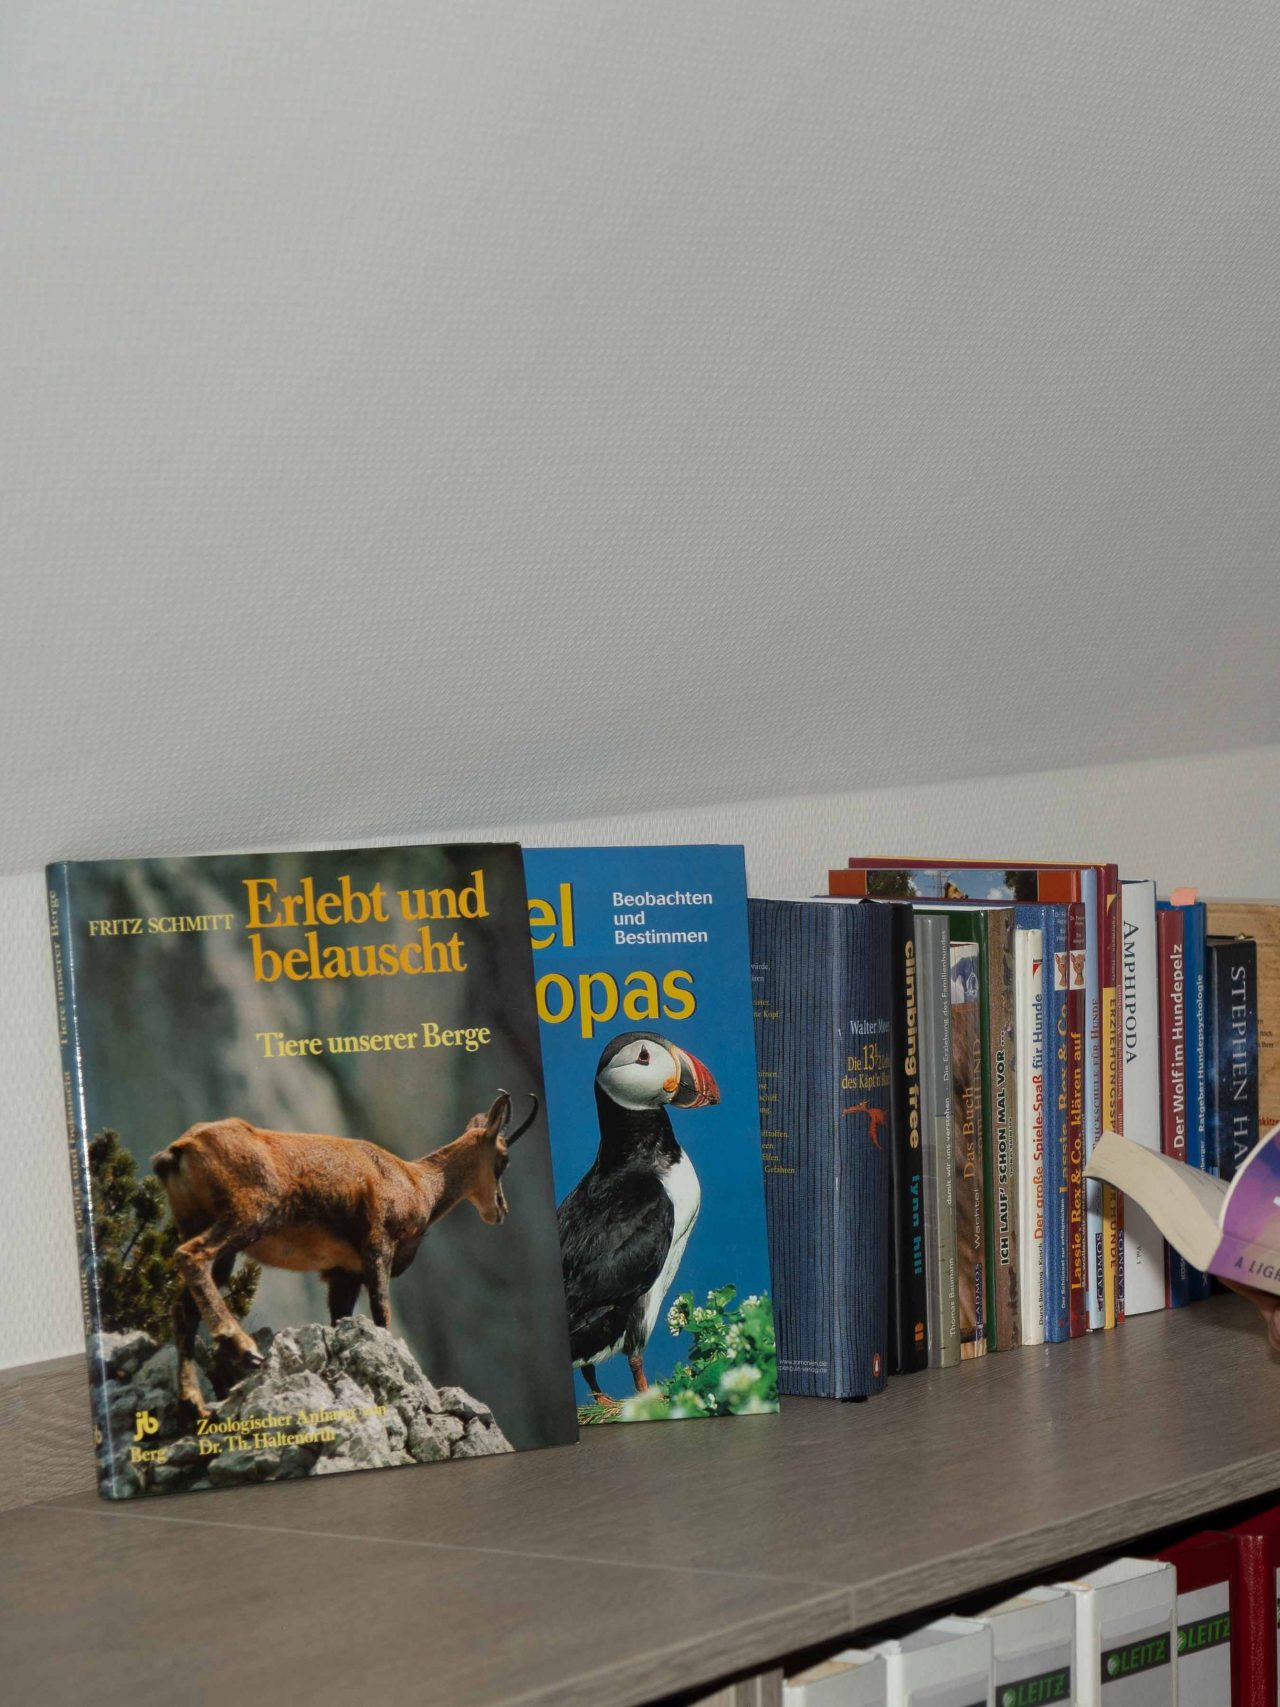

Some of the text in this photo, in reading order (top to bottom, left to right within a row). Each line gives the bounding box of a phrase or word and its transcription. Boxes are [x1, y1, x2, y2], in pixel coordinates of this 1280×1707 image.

[50, 890, 60, 937] Berge
[242, 869, 489, 928] Erlebt und
[612, 891, 713, 907] Beobachten
[88, 913, 234, 937] FRITZ SCHMITT
[614, 911, 646, 926] und
[614, 930, 708, 945] Bestimmen
[248, 925, 468, 983] belauscht
[940, 930, 948, 998] Familienhundes
[1123, 921, 1140, 1065] AMPHIPODA
[850, 1019, 877, 1035] Walter
[1090, 999, 1099, 1039] HUNDE
[1197, 974, 1206, 1079] Hundepsychologie
[1230, 965, 1249, 1101] STEPHEN
[256, 1023, 491, 1057] Tiere unserer Berge
[904, 939, 920, 1149] climbing free
[941, 1019, 951, 1063] Erziehung
[1091, 1042, 1099, 1060] FÜR
[1169, 943, 1185, 1149] Der Wolf im Hundepelz
[841, 1074, 857, 1090] des
[848, 1057, 862, 1071] Die
[995, 1051, 1006, 1085] VOR
[943, 1098, 951, 1142] verstehen
[996, 1088, 1006, 1126] MAL
[1032, 993, 1044, 1241] Der große Spiele-Spaß für Hunde
[1198, 1081, 1206, 1133] Ratgeber
[962, 1086, 975, 1180] Das Buch
[999, 1128, 1009, 1184] SCHON
[1070, 1032, 1082, 1290] Lassie, Rex & Co. klären auf
[945, 1181, 953, 1206] damit
[1000, 1187, 1009, 1233] LAUF'
[909, 1174, 923, 1275] lynn hill
[973, 1188, 982, 1249] Wachtel
[1001, 1238, 1010, 1266] ICH
[1233, 1256, 1243, 1269] A
[948, 1257, 957, 1338] Thomas Baumann
[133, 1411, 159, 1442] jb
[197, 1412, 292, 1436] Zoologischer
[199, 1428, 336, 1456] Dr. Th. Haltenorth
[130, 1446, 168, 1464] Berg
[1187, 1613, 1230, 1649] LEITZ
[1120, 1637, 1167, 1673] LEITZ
[1018, 1673, 1065, 1705] LEITZ
